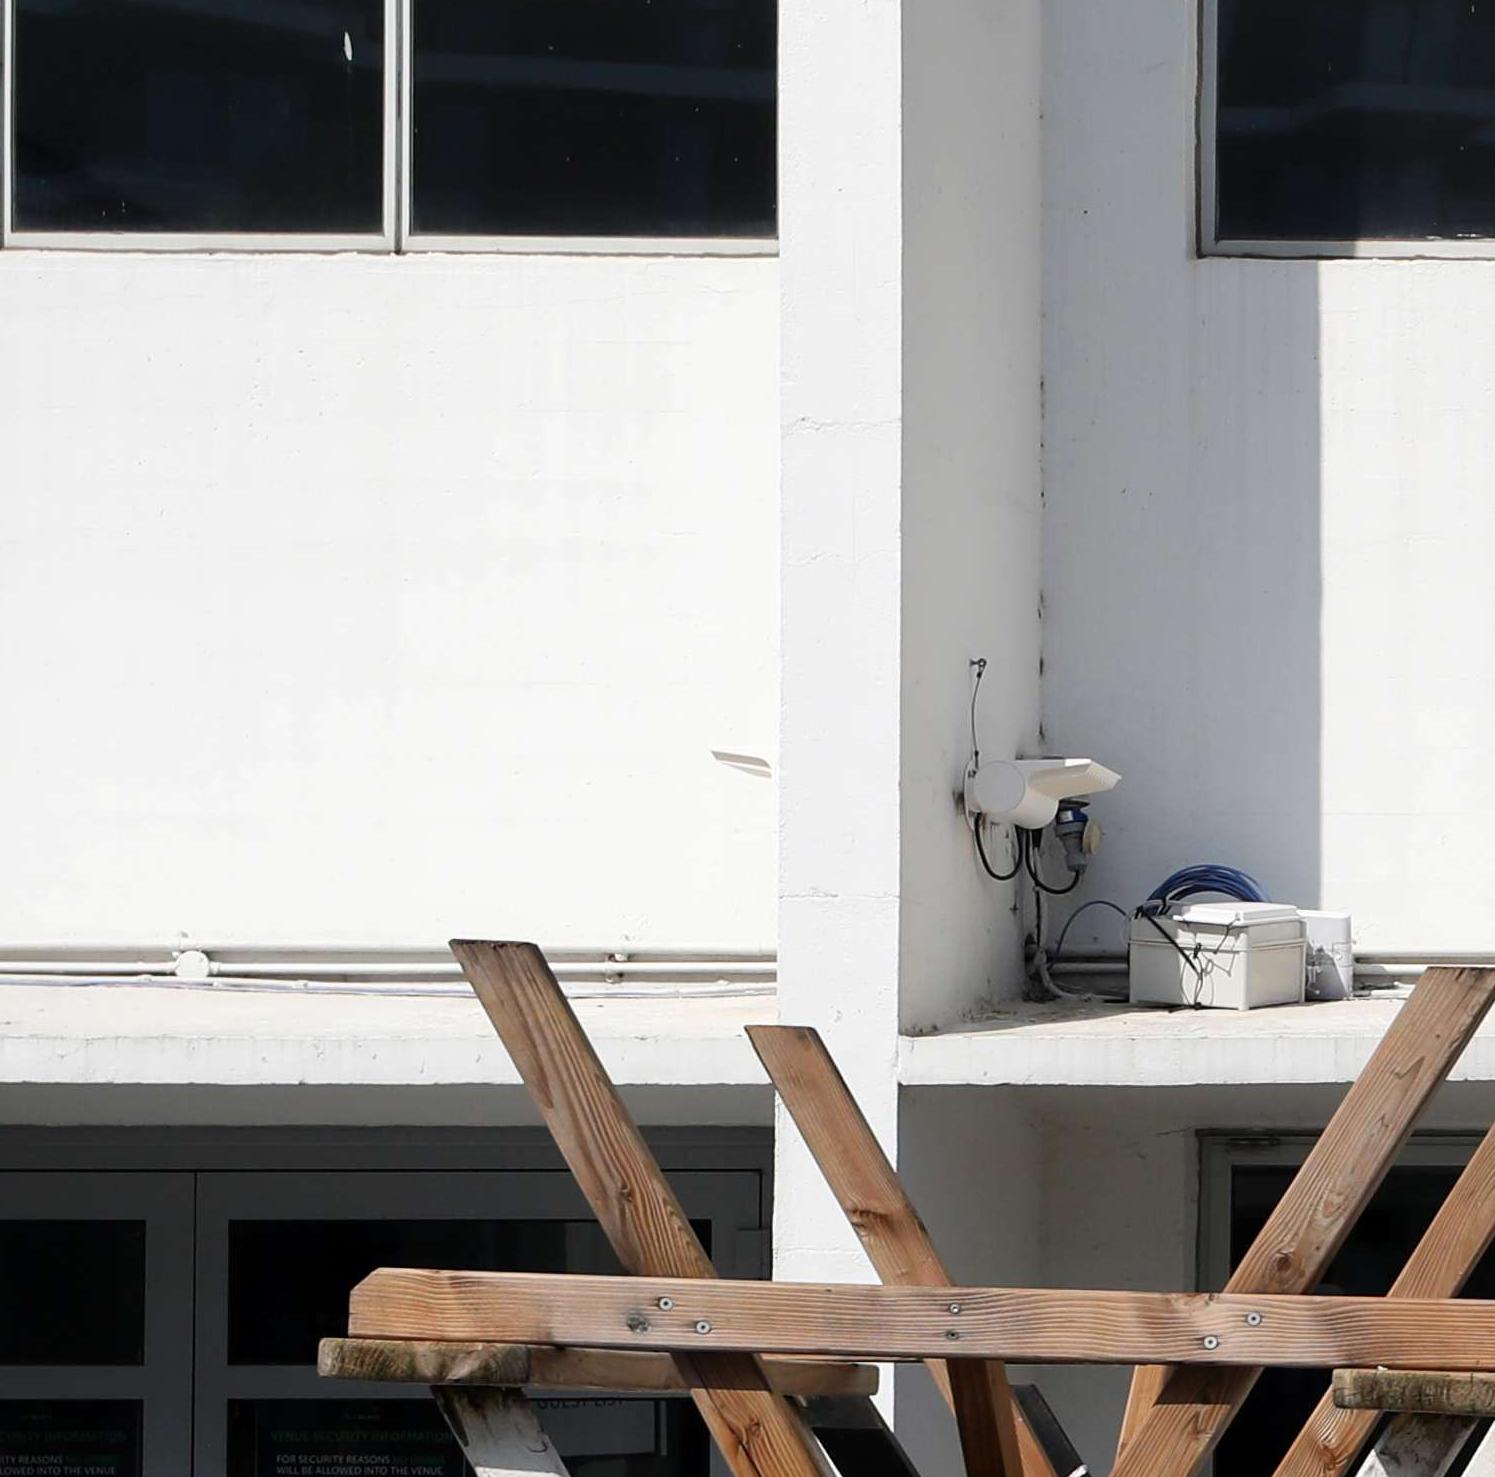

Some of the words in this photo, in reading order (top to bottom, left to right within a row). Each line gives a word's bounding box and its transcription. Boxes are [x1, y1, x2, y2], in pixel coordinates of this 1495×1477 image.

[276, 1454, 297, 1464] FOR
[299, 1454, 345, 1464] SECURITY
[347, 1454, 391, 1464] REASONS
[276, 1466, 300, 1476] WILL
[302, 1466, 314, 1476] BE
[315, 1466, 363, 1476] ALLOWED
[364, 1466, 389, 1476] INTO
[390, 1466, 409, 1476] THE
[411, 1466, 445, 1476] VENUE
